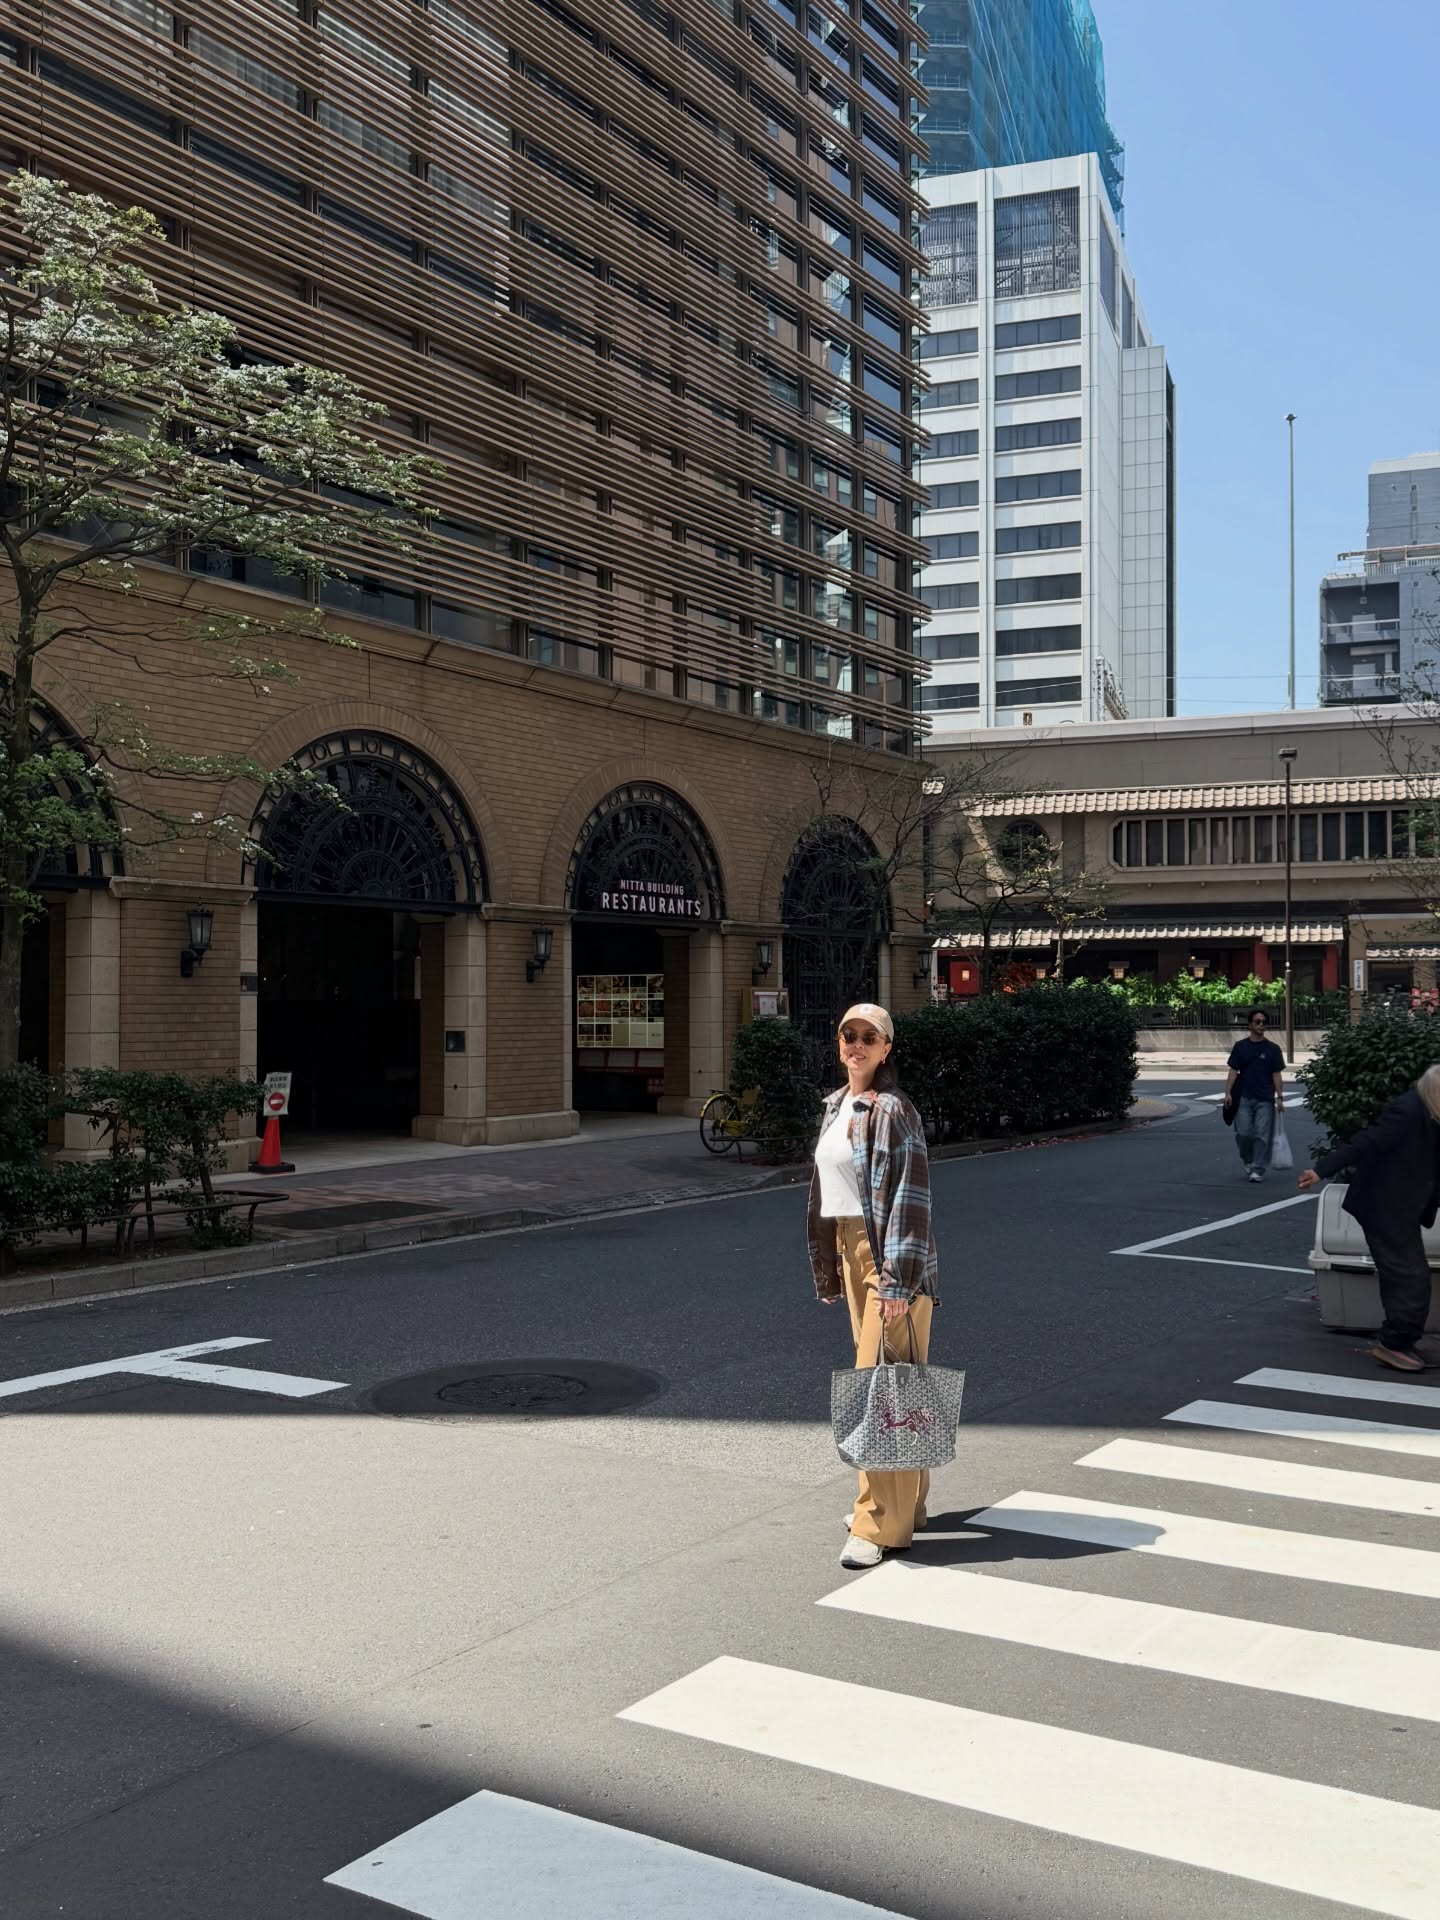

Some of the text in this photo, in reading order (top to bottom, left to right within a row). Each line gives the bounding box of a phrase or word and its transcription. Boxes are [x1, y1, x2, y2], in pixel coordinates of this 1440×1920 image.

[620, 879, 684, 896] NITTA BUILDING
[602, 892, 701, 916] RESTAURANTS
